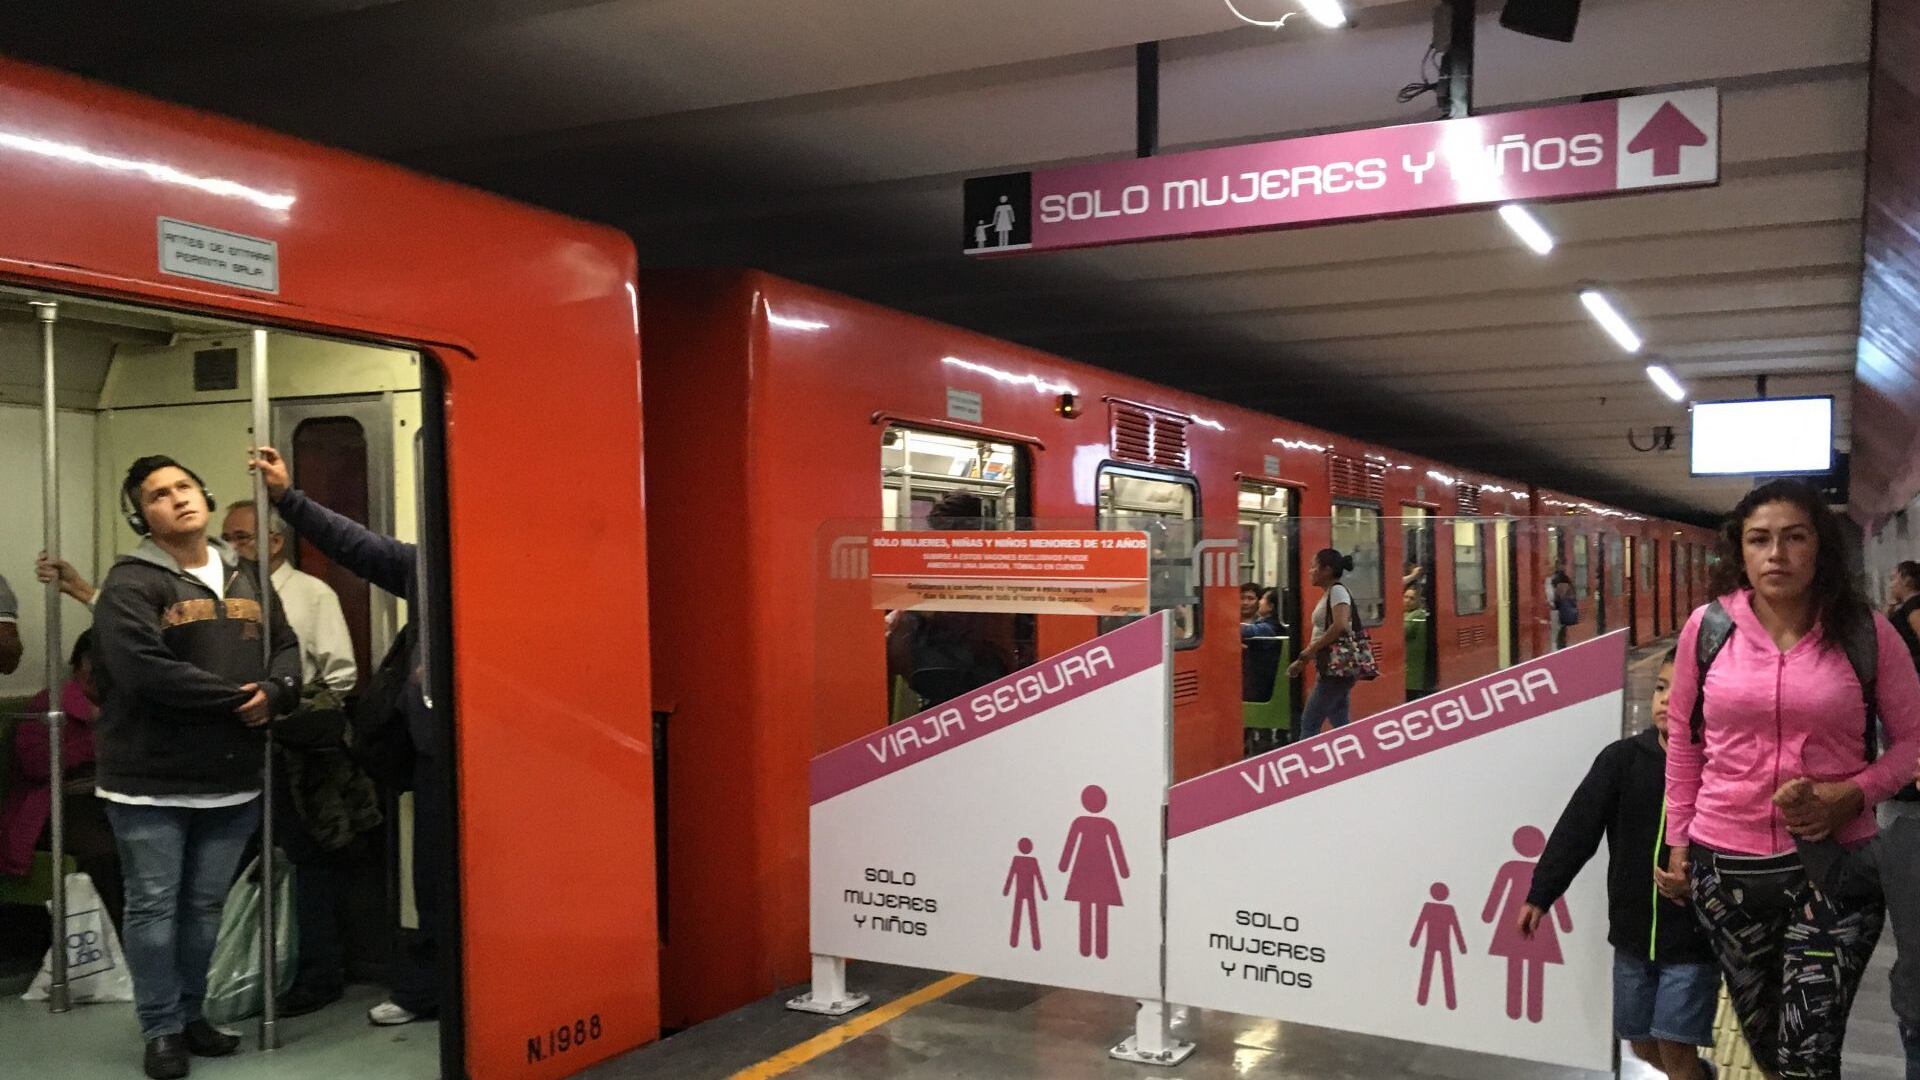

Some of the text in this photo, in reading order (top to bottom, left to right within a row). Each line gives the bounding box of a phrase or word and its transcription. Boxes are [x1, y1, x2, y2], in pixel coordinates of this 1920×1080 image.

[1039, 184, 1149, 223] SOLO
[1163, 157, 1387, 211] MUJERES
[1401, 150, 1435, 185] Y
[985, 538, 993, 547] Y
[1029, 538, 1081, 548] MENORES
[1083, 539, 1098, 548] DE
[1101, 539, 1114, 549] 12
[1115, 538, 1147, 549] AÑOS
[866, 645, 1115, 764] VIAJA SEGURA
[1240, 667, 1558, 794] VIAJA SEGURA
[865, 868, 916, 886] SOLO
[844, 889, 937, 913] MUJERES
[853, 913, 927, 936] Y NIÑOS
[1236, 910, 1299, 932] SOLO
[1209, 933, 1326, 963] MUJERES
[1220, 961, 1313, 989] Y NIÑOS
